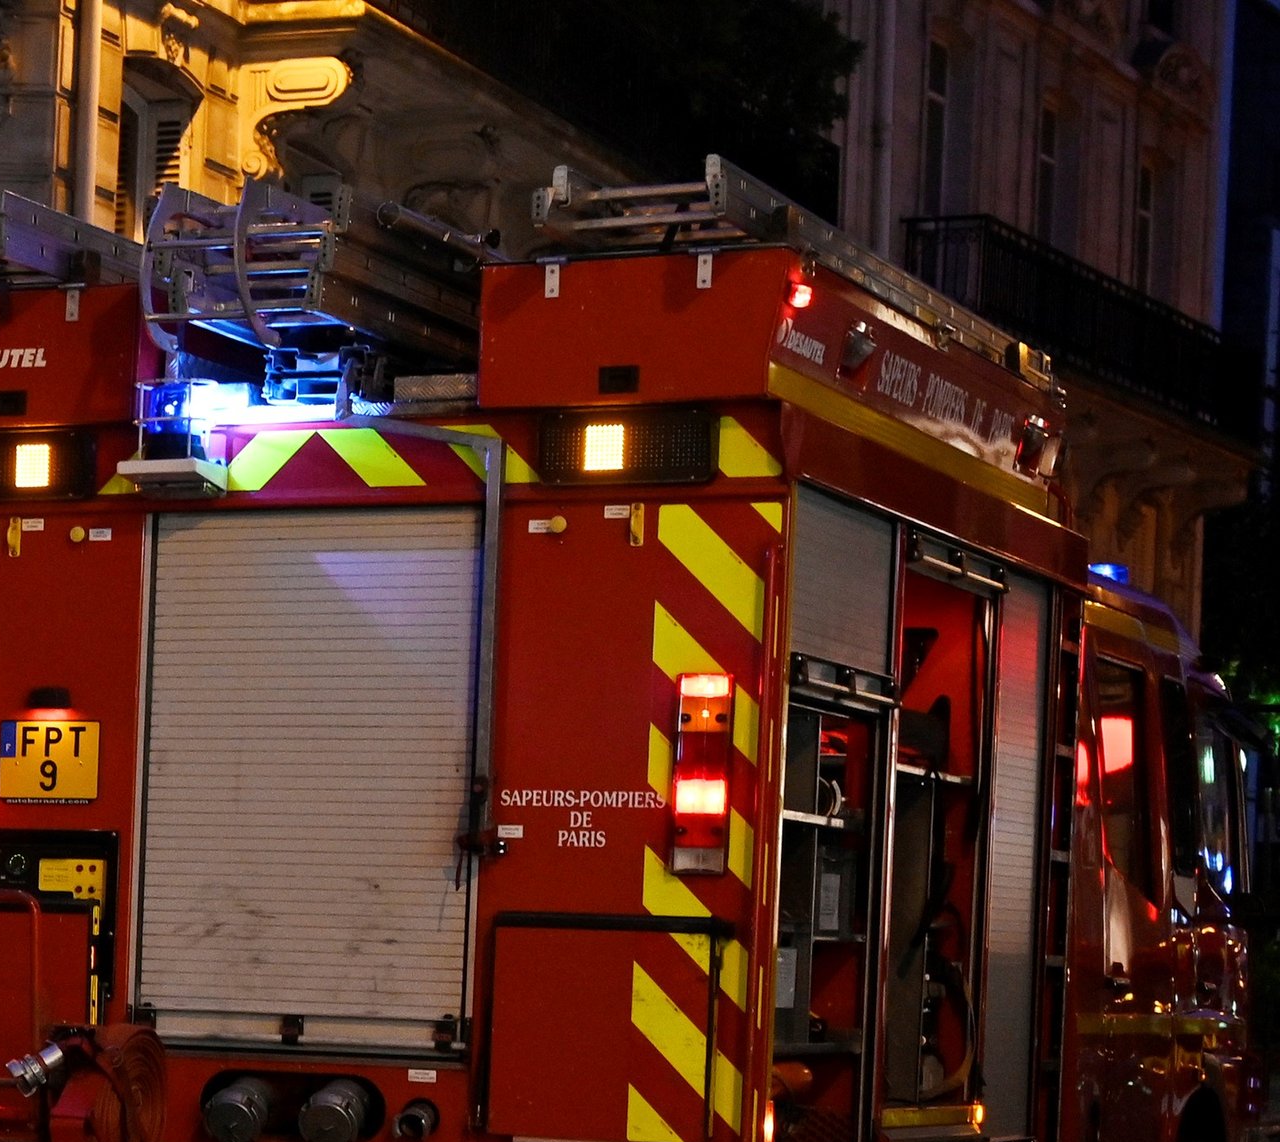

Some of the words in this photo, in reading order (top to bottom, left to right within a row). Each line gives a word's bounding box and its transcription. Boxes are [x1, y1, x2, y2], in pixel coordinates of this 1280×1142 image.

[788, 329, 826, 366] DESAUTEL
[877, 349, 922, 408] SAPEURS
[922, 372, 969, 424] POMPIERS
[21, 726, 86, 757] FPT
[39, 760, 57, 791] 9
[500, 789, 667, 809] SAPEURS-POMPIERS
[569, 811, 592, 828] DE
[557, 830, 606, 848] PARIS
